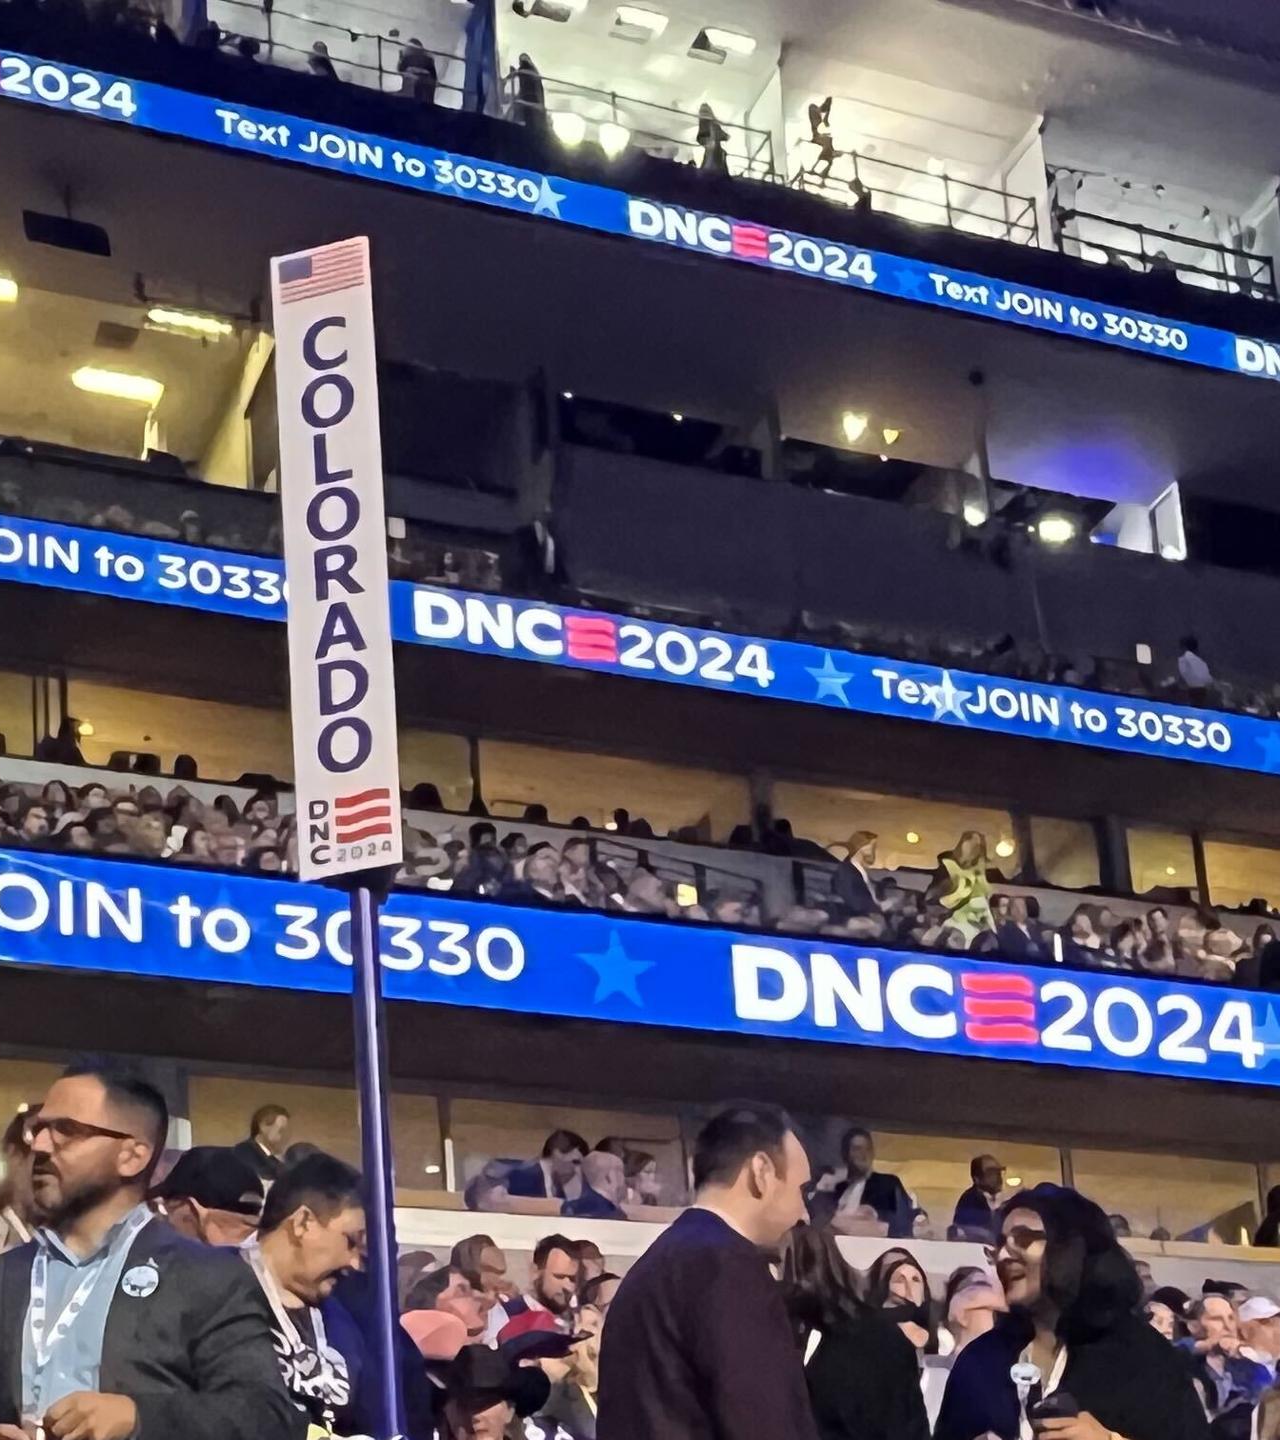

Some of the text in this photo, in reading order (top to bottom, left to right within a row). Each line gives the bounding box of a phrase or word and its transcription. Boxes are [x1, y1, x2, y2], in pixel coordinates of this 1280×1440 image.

[0, 58, 136, 117] 2024
[216, 110, 539, 202] Text JOIN to 30330
[629, 201, 876, 283] DNC 2024
[930, 274, 1187, 350] Text JOIN to 30330
[95, 547, 144, 581] to
[159, 554, 287, 604] 3033
[301, 317, 372, 773] COLORADO
[414, 590, 774, 687] DNC 2024
[873, 668, 1230, 751] Text JOIN to 30330
[309, 800, 331, 865] DNC
[169, 896, 250, 952] to
[276, 899, 524, 985] 30330
[732, 944, 1264, 1069] DNC 2024
